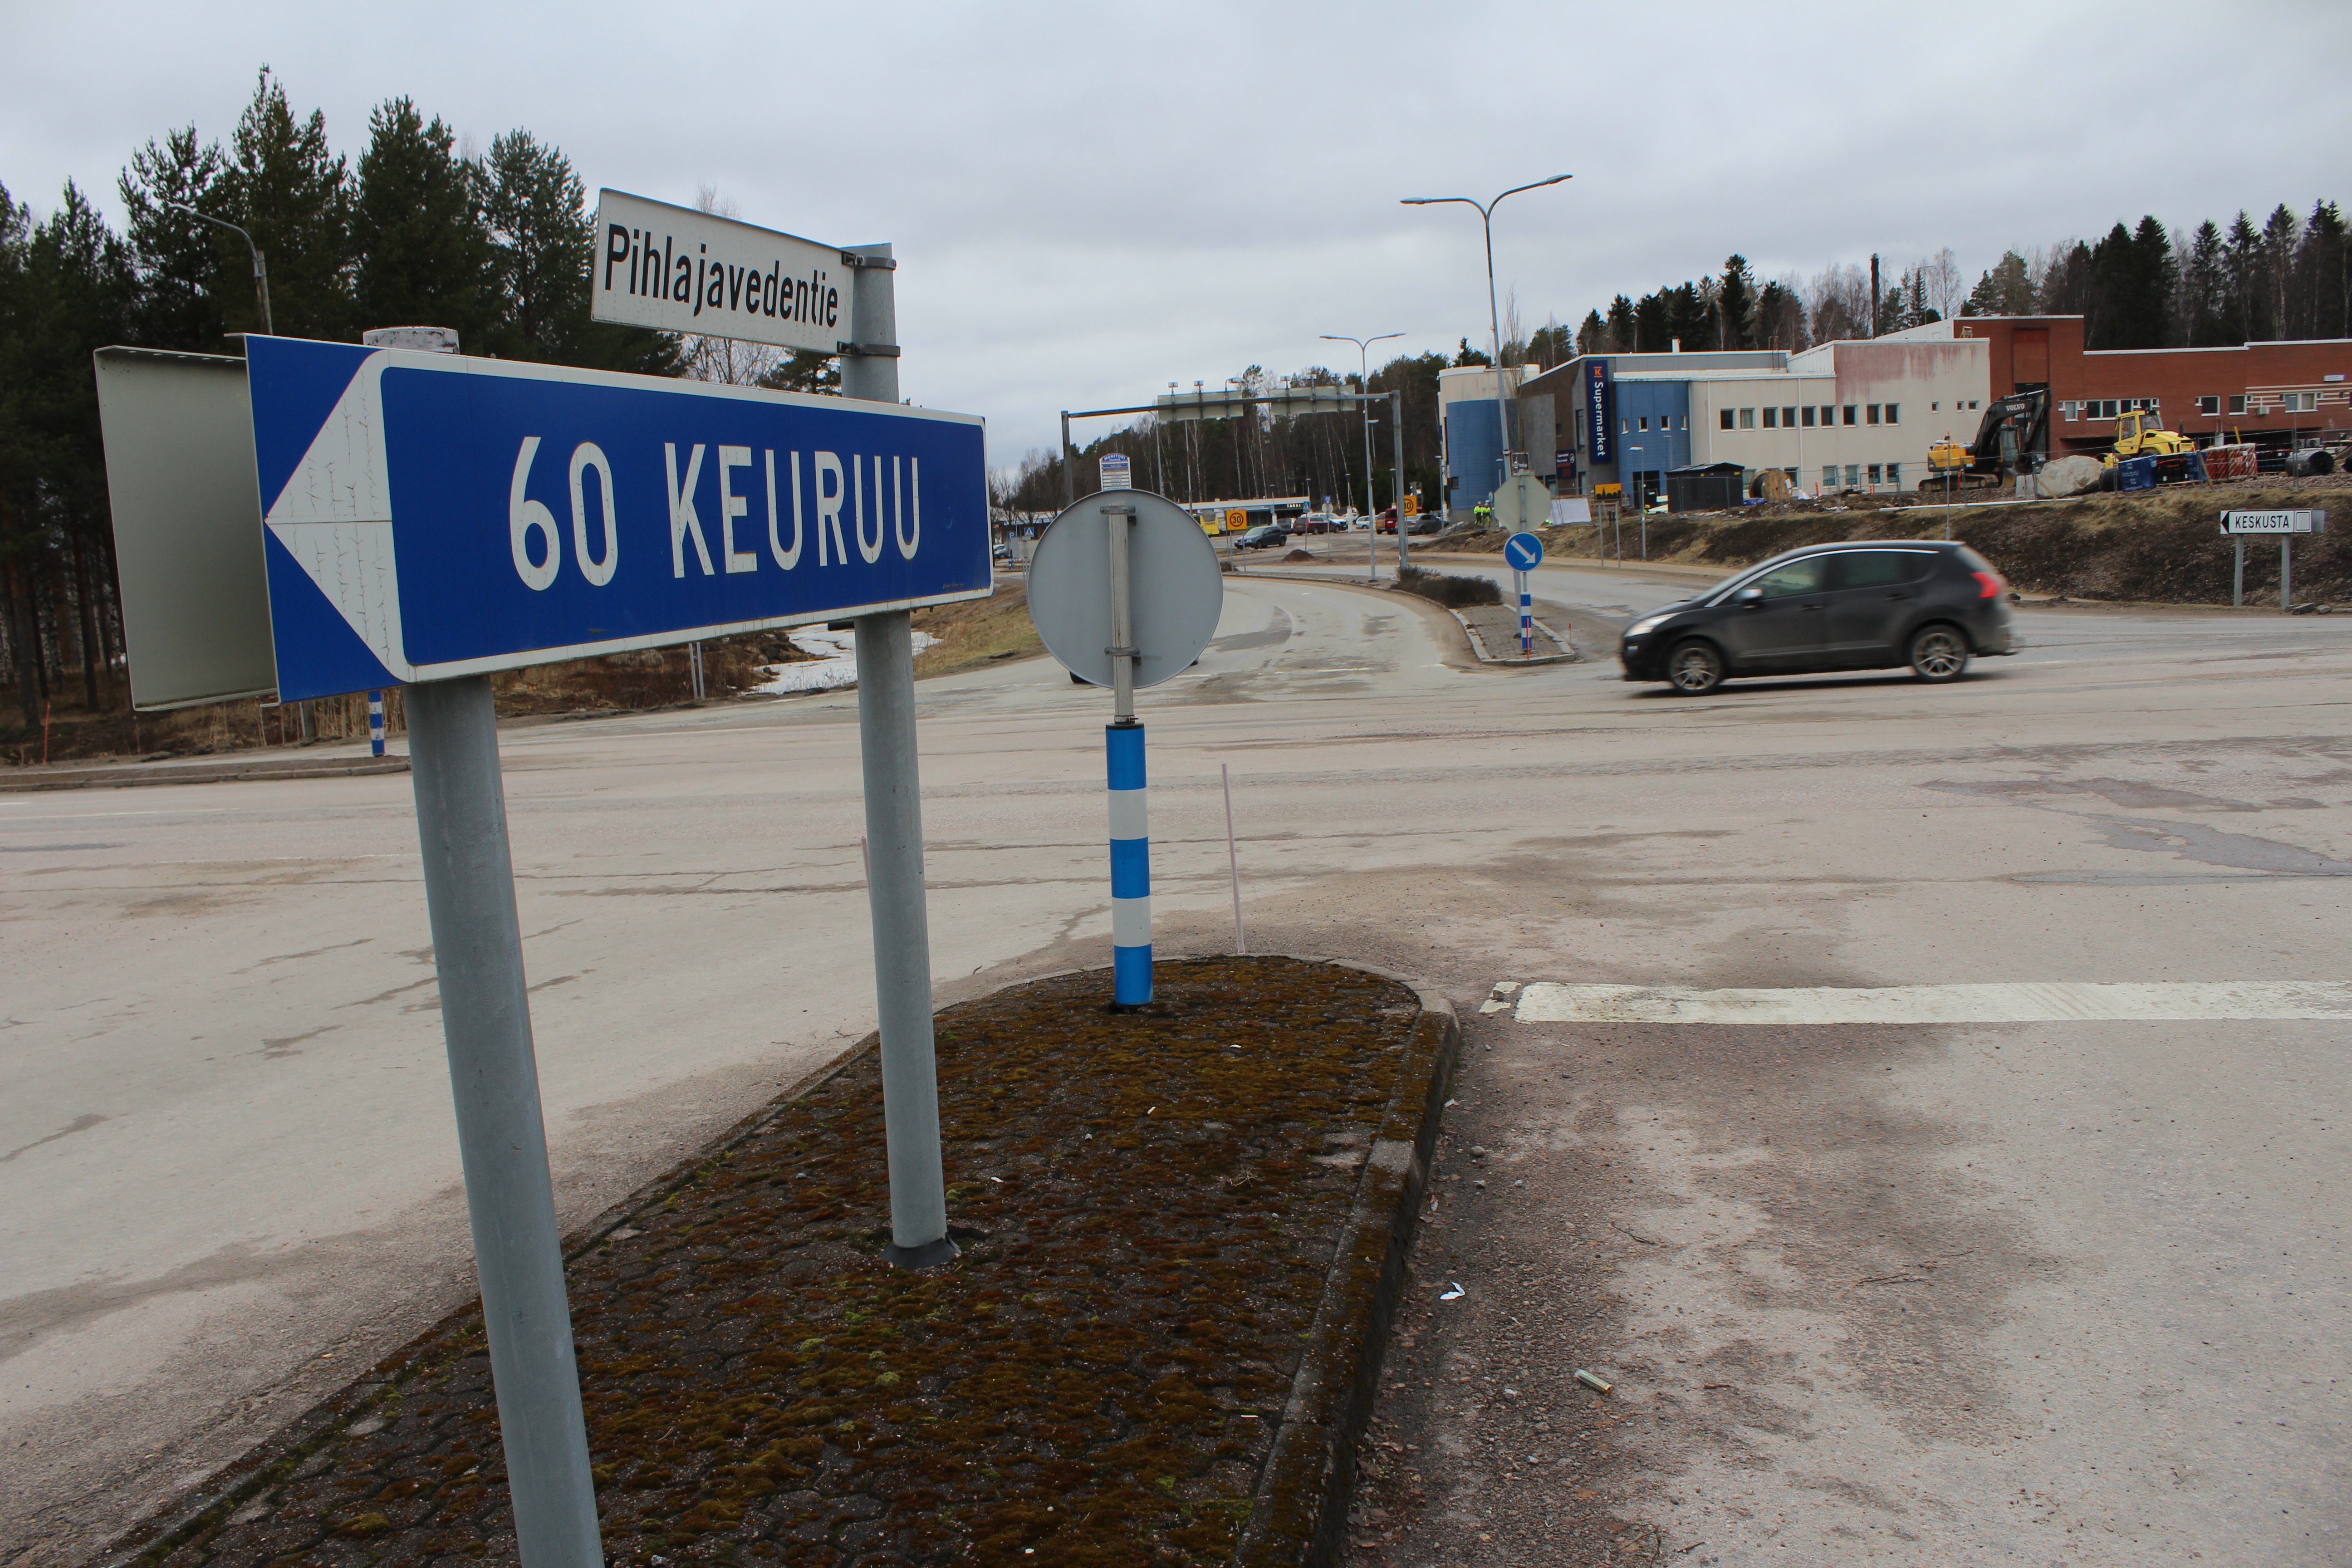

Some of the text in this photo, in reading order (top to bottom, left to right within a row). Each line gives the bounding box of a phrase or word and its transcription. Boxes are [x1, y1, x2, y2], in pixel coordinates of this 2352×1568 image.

[604, 223, 839, 328] Pihlajavedentie
[1593, 367, 1606, 456] K Supermarket
[510, 436, 920, 591] 60 KEURUU
[2235, 515, 2289, 529] KESKUSTA
